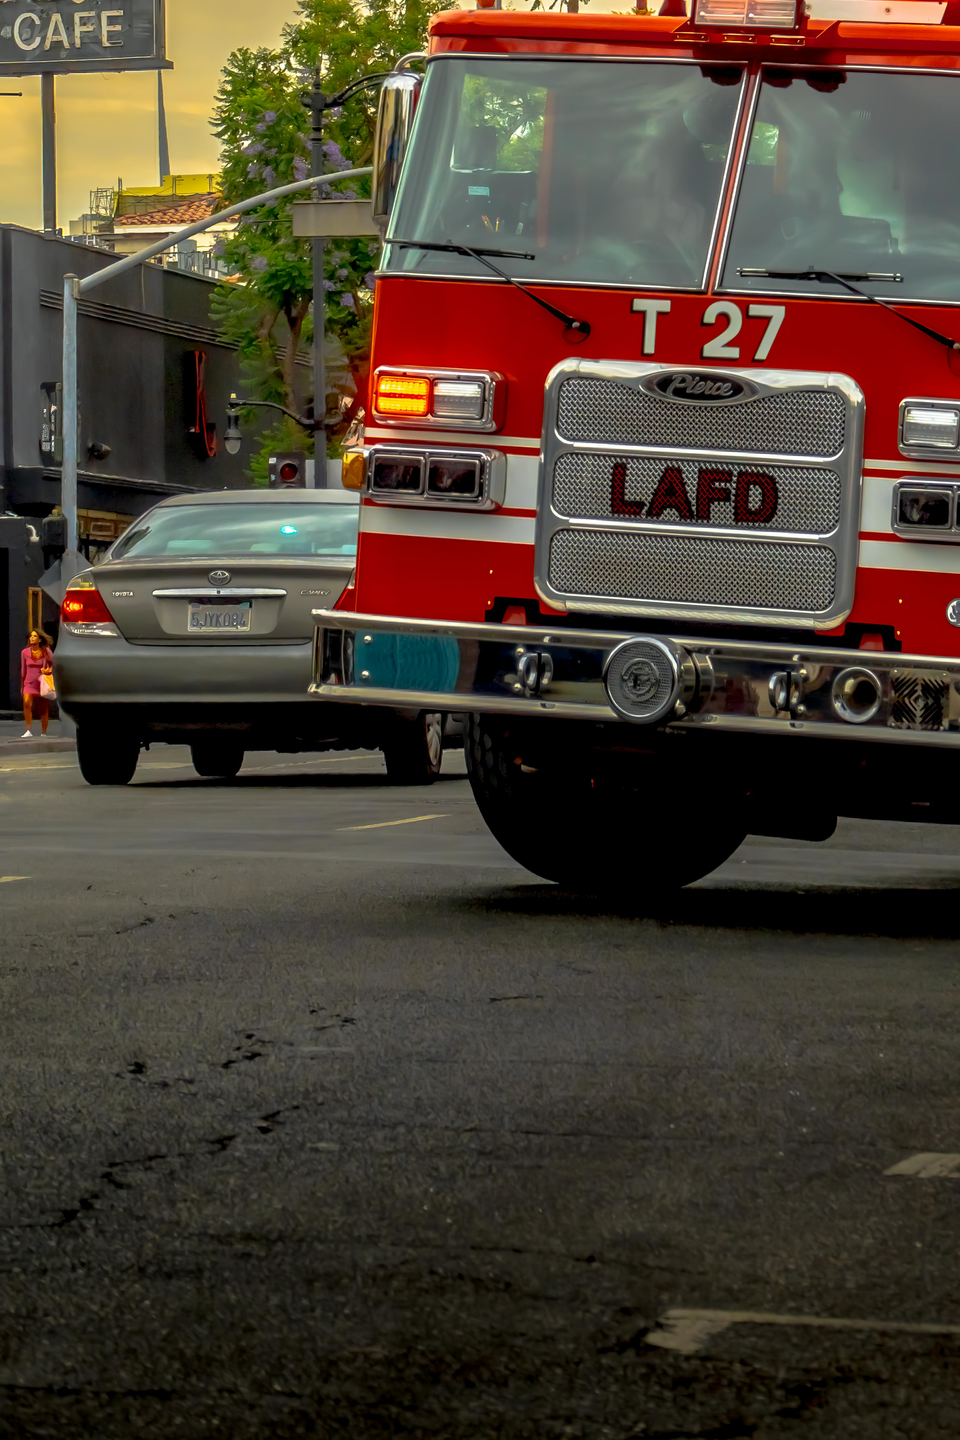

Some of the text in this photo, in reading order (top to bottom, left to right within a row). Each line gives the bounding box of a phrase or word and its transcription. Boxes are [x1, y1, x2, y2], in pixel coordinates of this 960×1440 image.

[13, 10, 124, 51] CAFE
[633, 299, 785, 360] T 27
[666, 374, 733, 396] Pierce
[611, 462, 778, 523] LAFD
